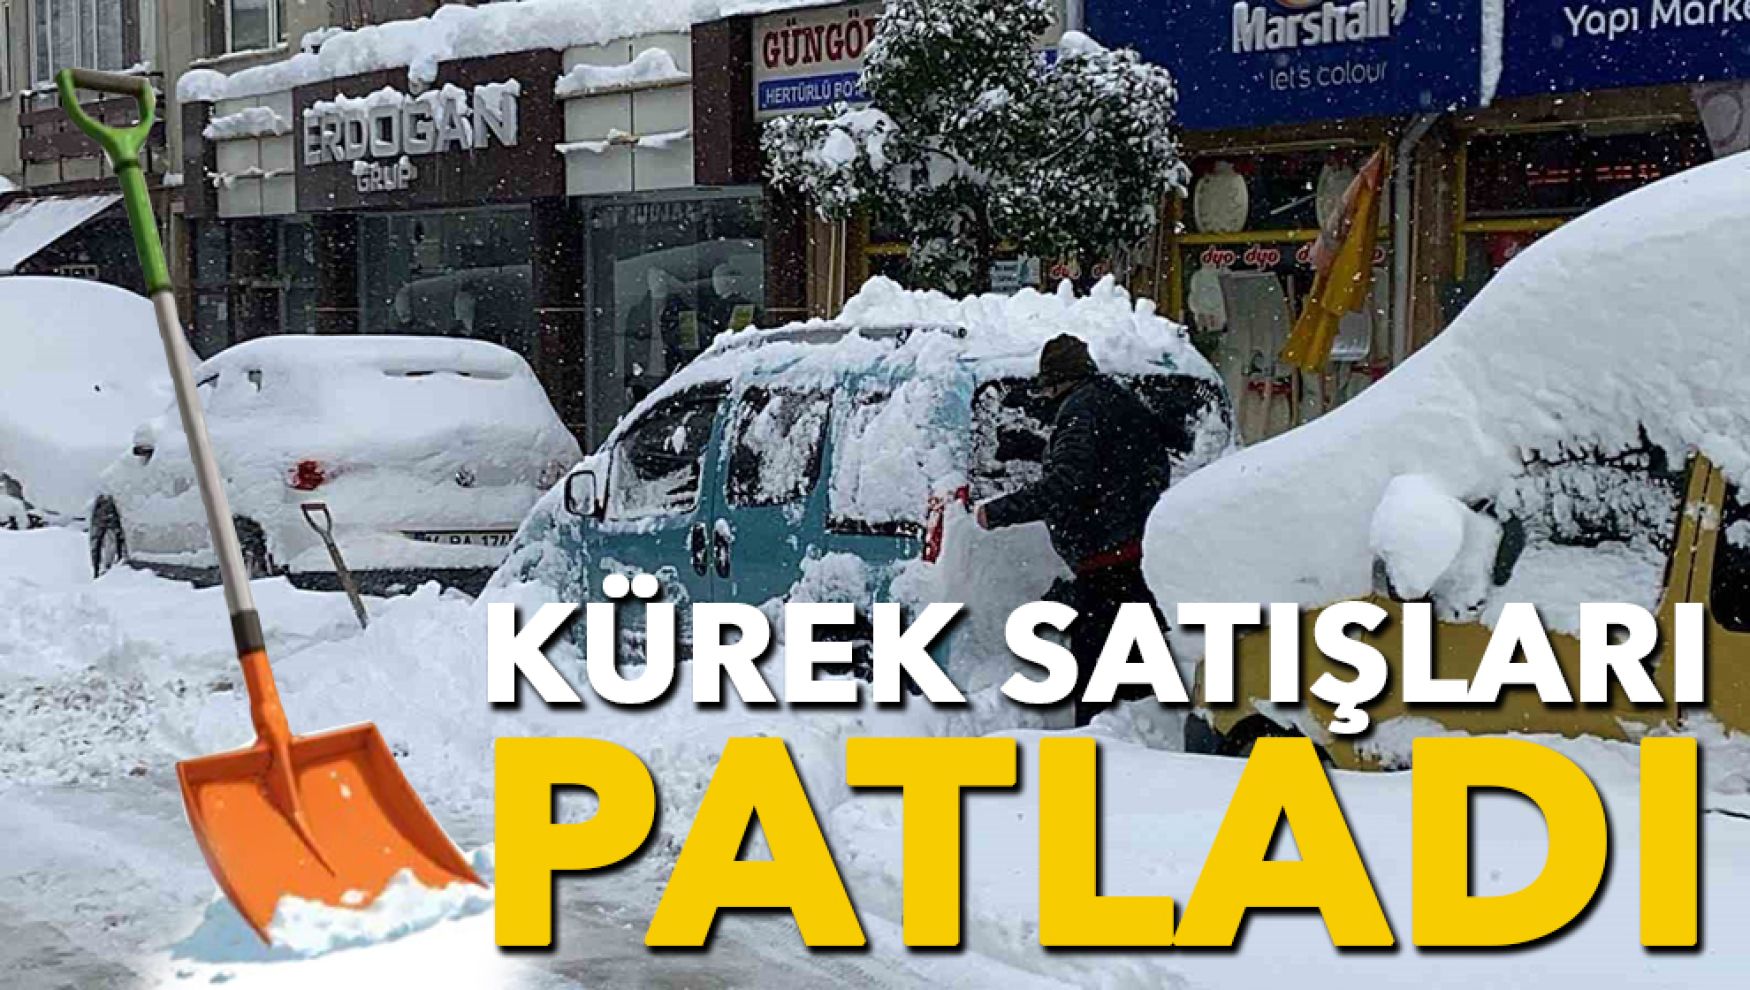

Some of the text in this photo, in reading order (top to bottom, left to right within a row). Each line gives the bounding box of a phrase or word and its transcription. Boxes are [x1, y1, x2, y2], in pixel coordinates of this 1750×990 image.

[1232, 0, 1391, 53] Marshall
[1563, 4, 1640, 41] Yapı
[1316, 60, 1388, 86] colour
[1201, 245, 1237, 269] dyo
[1244, 243, 1281, 270] dyo
